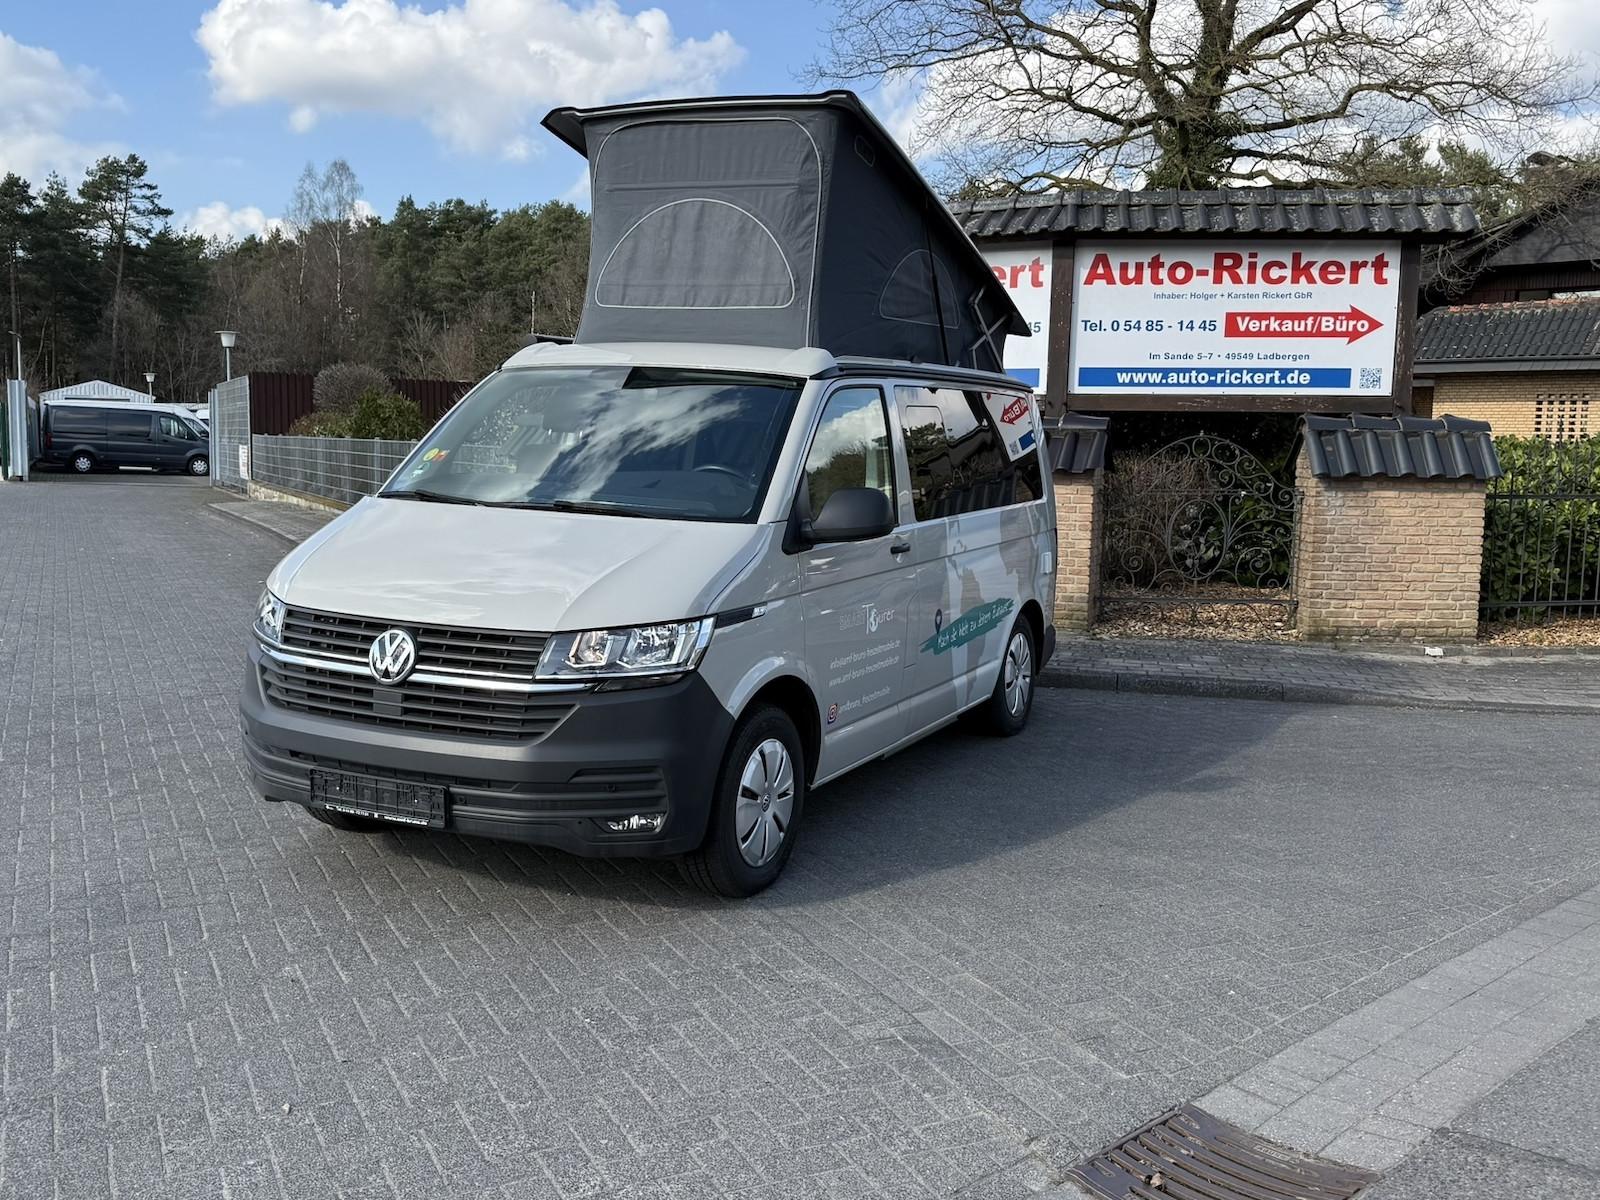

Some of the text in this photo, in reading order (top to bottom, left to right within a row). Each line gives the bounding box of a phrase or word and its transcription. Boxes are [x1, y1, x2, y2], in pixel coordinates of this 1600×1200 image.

[1083, 252, 1389, 285] Auto-Rickert
[1153, 291, 1188, 300] Inhaber:
[1189, 291, 1218, 302] Holger
[1227, 291, 1260, 300] Karsten
[1261, 291, 1292, 300] Rickert
[1293, 291, 1313, 300] GbR
[1081, 319, 1107, 332] Tel.
[1236, 315, 1370, 333] Verkauf/Büro
[1149, 352, 1161, 360] Im
[1163, 352, 1194, 360] Sande
[1224, 352, 1254, 360] 49549
[1257, 352, 1311, 362] Ladbergen
[1116, 369, 1311, 385] www.auto-rickert.de
